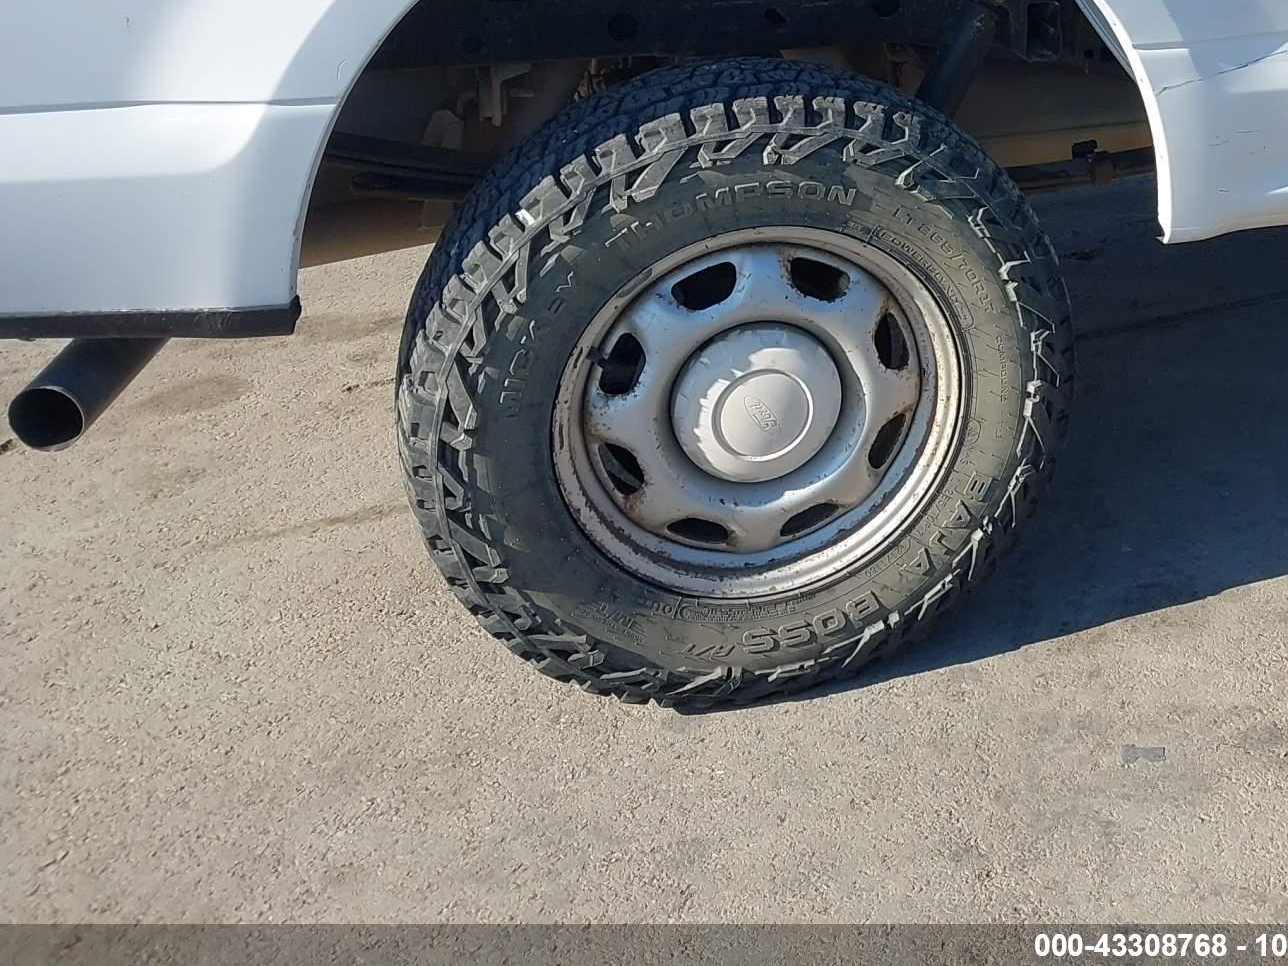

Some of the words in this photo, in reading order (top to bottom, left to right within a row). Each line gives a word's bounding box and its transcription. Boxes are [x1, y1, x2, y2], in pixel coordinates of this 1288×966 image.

[604, 180, 857, 250] THOMPSON
[900, 471, 992, 580] BAJA
[742, 590, 882, 651] BOSS
